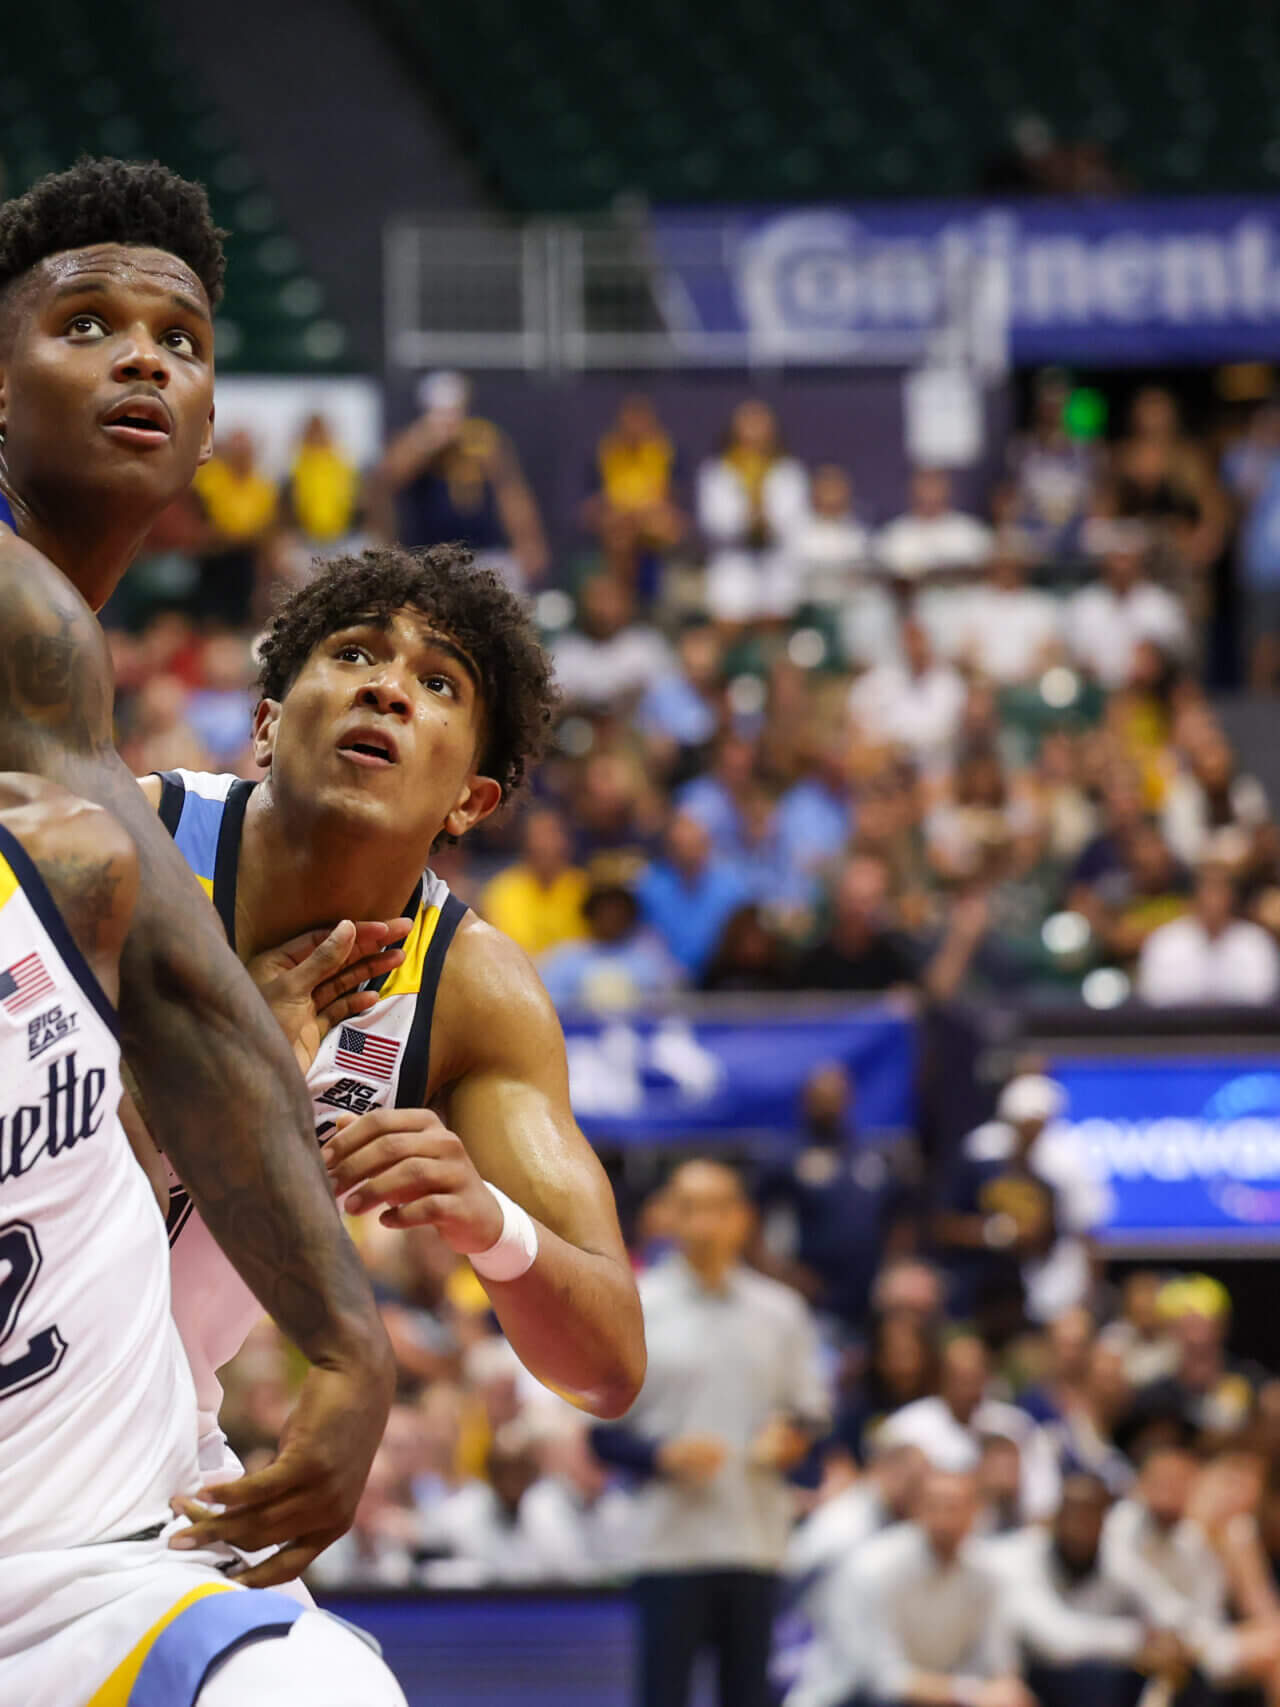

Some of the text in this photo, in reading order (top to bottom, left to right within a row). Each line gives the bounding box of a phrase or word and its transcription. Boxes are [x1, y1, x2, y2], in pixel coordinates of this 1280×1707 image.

[27, 1004, 62, 1036] BIG
[28, 1012, 79, 1056] EAST
[320, 1087, 383, 1114] EAST
[334, 1077, 379, 1100] BIG
